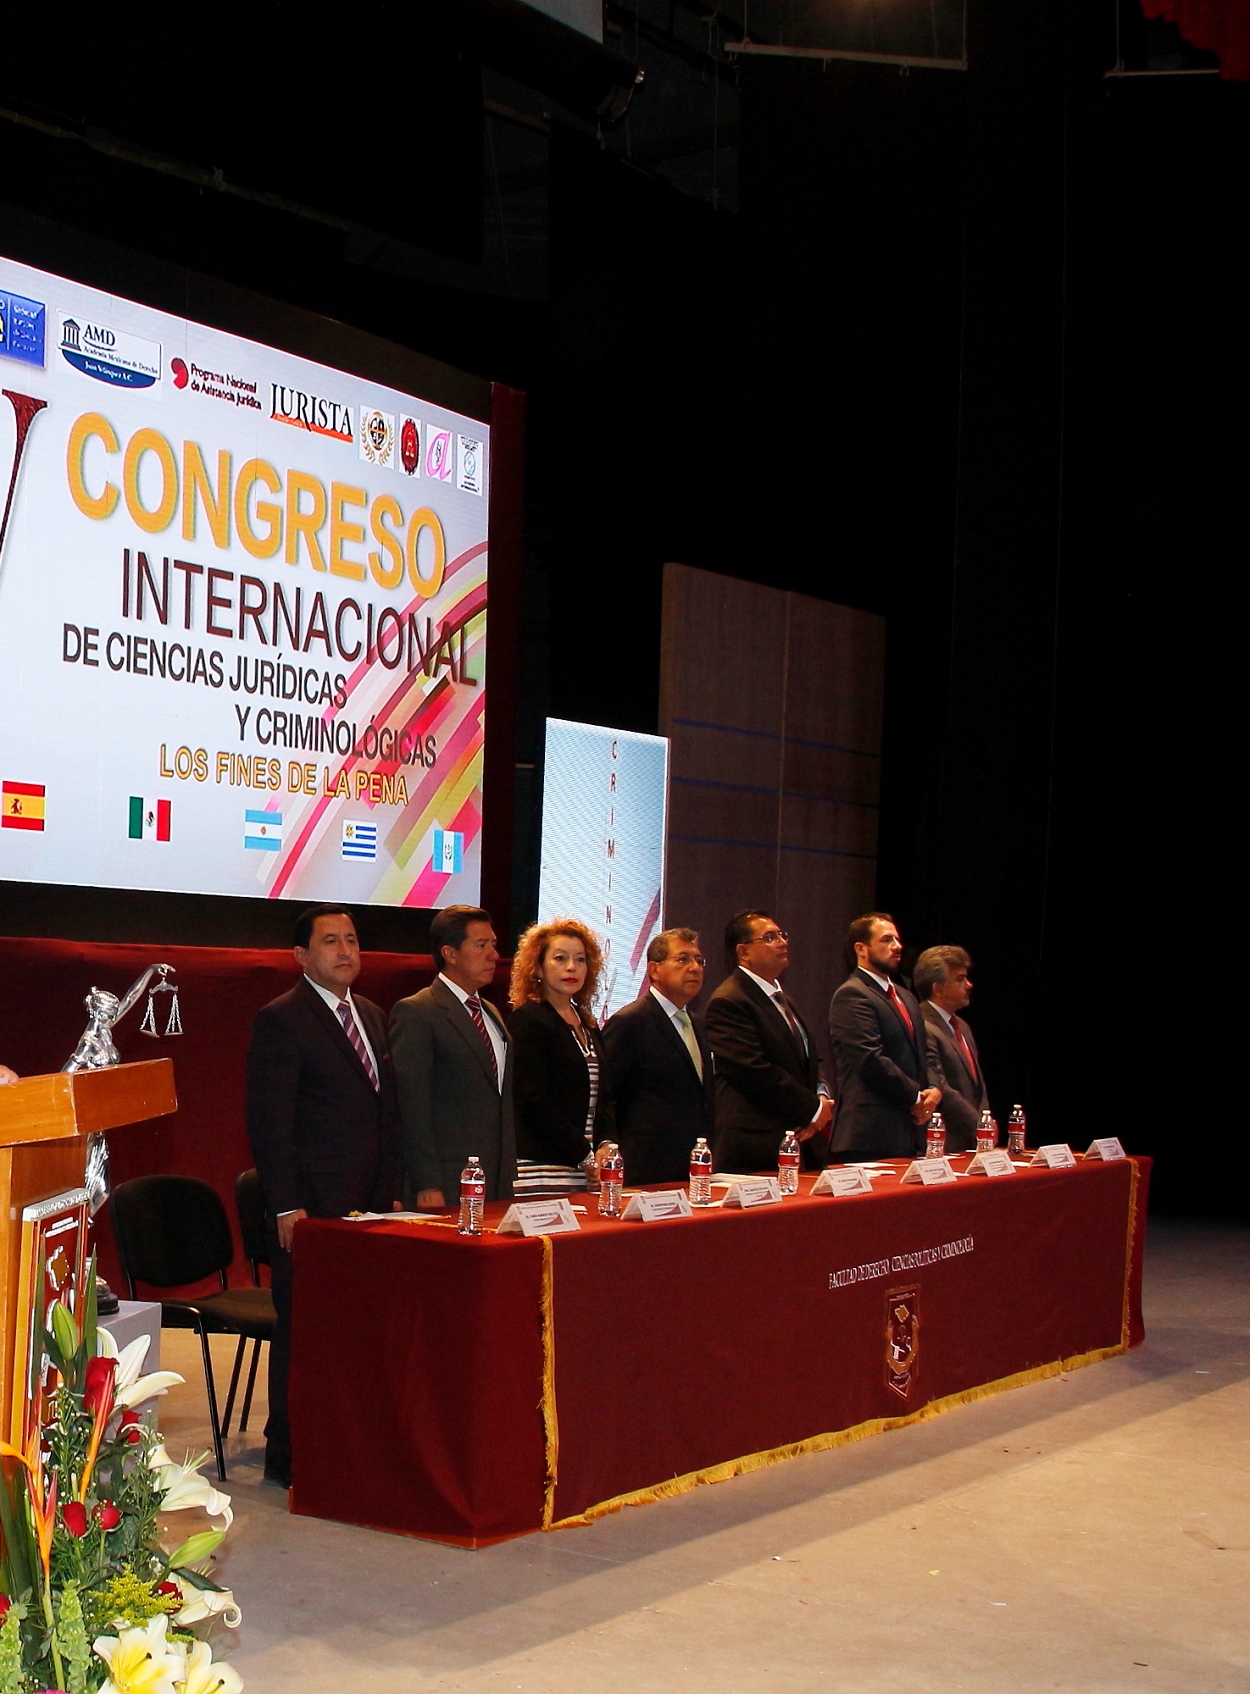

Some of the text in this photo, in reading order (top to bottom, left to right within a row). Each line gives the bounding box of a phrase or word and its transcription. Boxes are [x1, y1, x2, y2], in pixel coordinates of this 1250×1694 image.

[84, 324, 116, 346] AMD
[191, 363, 257, 393] Programa Nacional
[191, 379, 200, 391] de
[270, 382, 353, 437] JURISTA
[66, 411, 447, 599] CONGRESO
[122, 548, 478, 688] INTERNACIONAL
[63, 623, 347, 709] DE CIENCIAS JURÍDICAS
[234, 704, 437, 768] Y CRIMINOLÓGICAS
[160, 743, 409, 806] LOS FINES DE LA PENA
